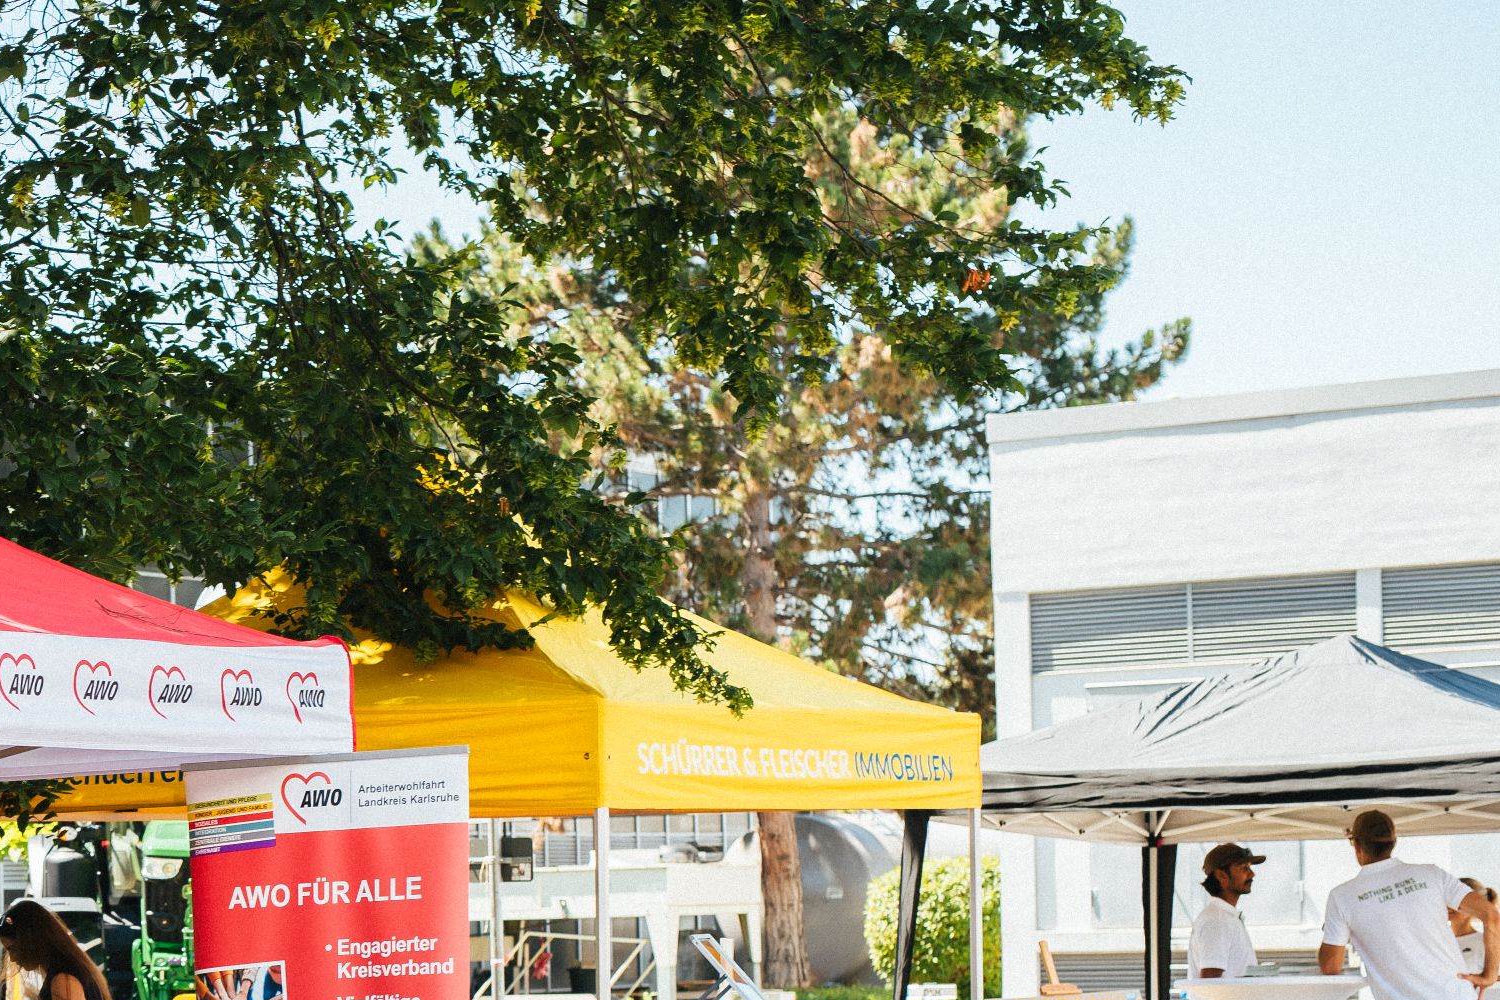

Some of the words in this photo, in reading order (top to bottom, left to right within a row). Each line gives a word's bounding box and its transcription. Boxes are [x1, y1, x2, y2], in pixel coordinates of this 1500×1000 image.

[9, 673, 44, 696] AWO
[83, 680, 119, 701] AWO
[157, 684, 193, 704] AWO
[230, 687, 262, 707] AWO
[298, 688, 326, 708] AWO
[637, 738, 739, 777] SCHÜRRER
[741, 746, 757, 775] &
[759, 747, 851, 778] FLEISCHER
[853, 751, 954, 782] IMMOBILIEN
[358, 780, 445, 794] Arbeiterwohlfahrt
[300, 788, 342, 808] AWO
[358, 794, 407, 807] Landkreis
[410, 792, 460, 805] Karlsruhe
[228, 884, 291, 910] AWO
[297, 877, 350, 906] FÜR
[355, 876, 422, 903] ALLE
[1358, 885, 1393, 902] NOTHING
[1379, 892, 1396, 903] LIKE
[337, 936, 438, 958] Engagierter
[337, 958, 454, 979] Kreisverband
